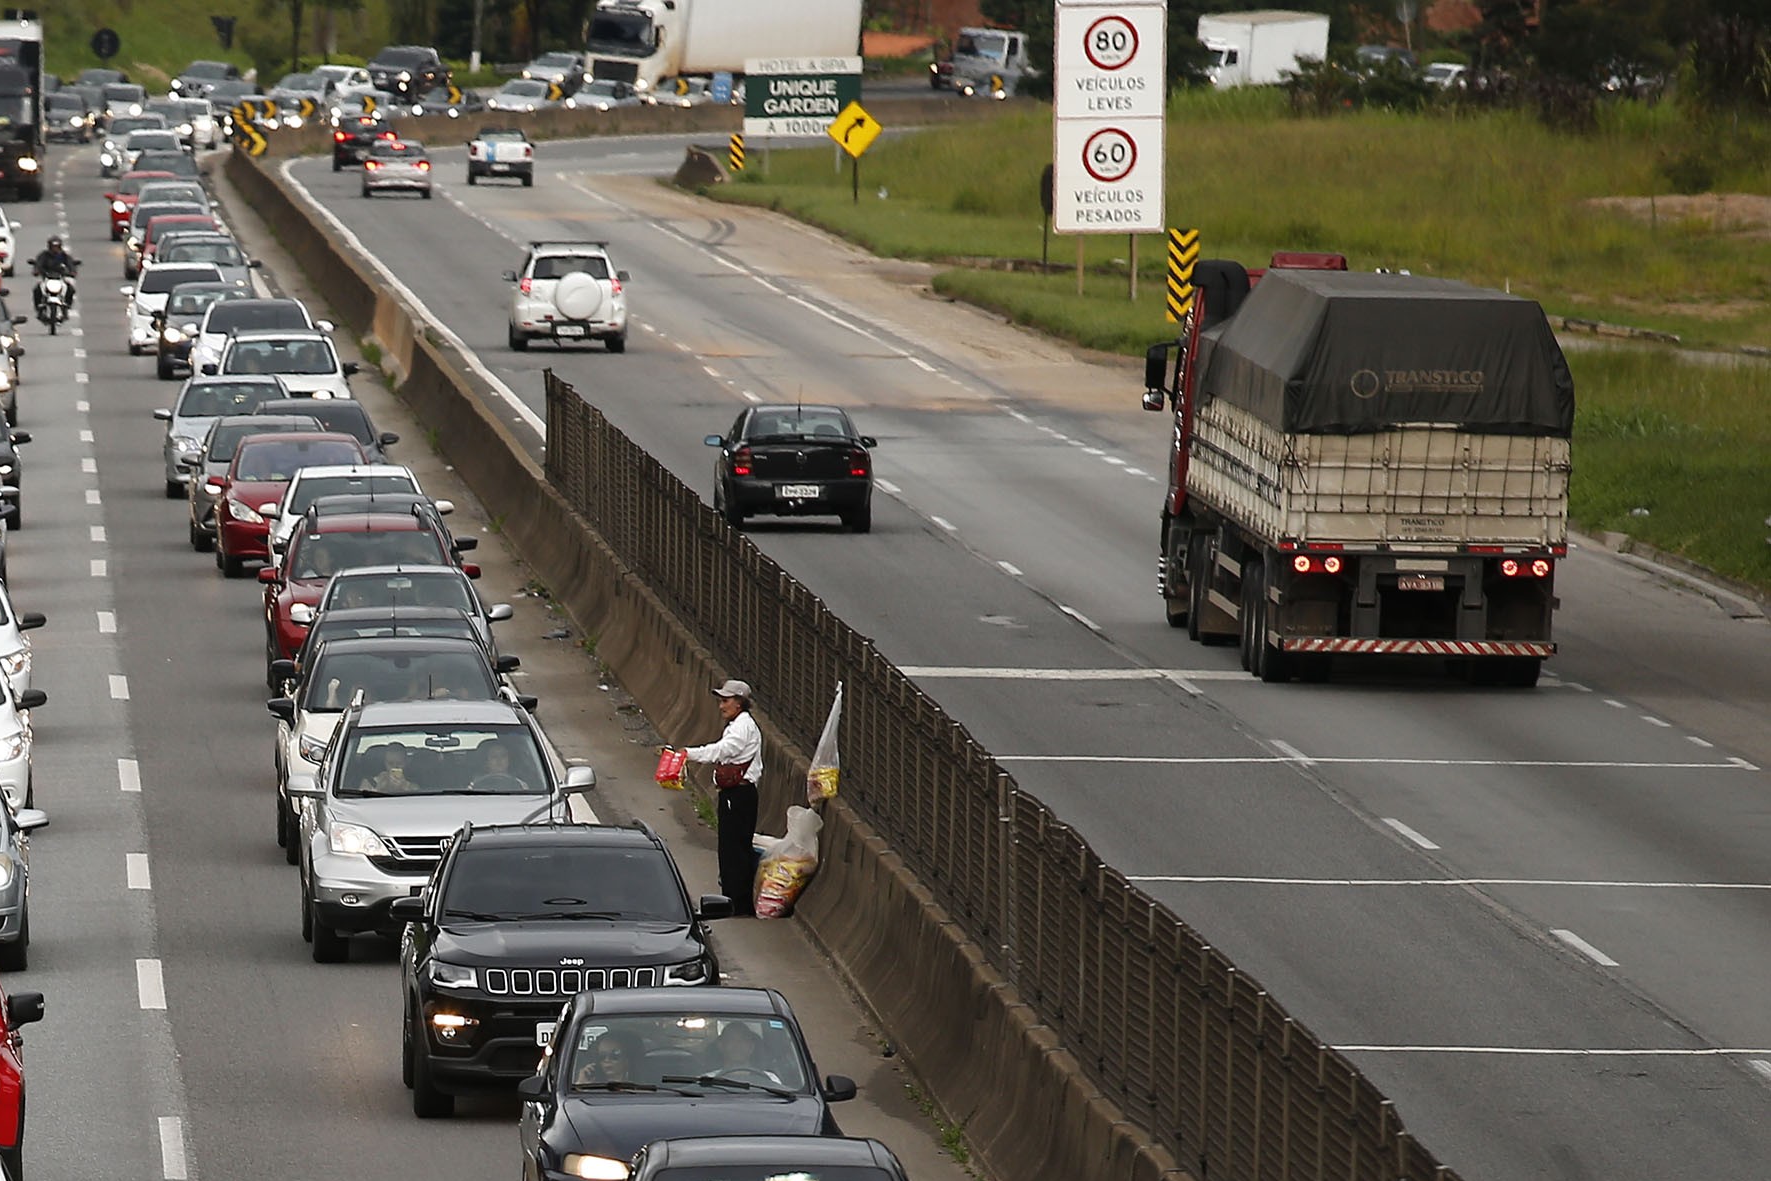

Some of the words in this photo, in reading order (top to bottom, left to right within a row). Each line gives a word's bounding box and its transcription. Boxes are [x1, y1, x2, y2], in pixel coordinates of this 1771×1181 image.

[1095, 30, 1127, 52] 80
[758, 60, 804, 71] HOTEL
[821, 59, 848, 71] SPA
[769, 79, 838, 97] UNIQUE
[1075, 75, 1146, 92] VEÍCULOS
[763, 97, 840, 115] GARDEN
[1087, 96, 1133, 111] LEVES
[1093, 142, 1126, 164] 60
[1074, 185, 1144, 204] VEÍCULOS
[1075, 209, 1142, 223] PESADOS
[1384, 370, 1485, 385] TRANSTICO
[559, 957, 584, 966] Jeep
